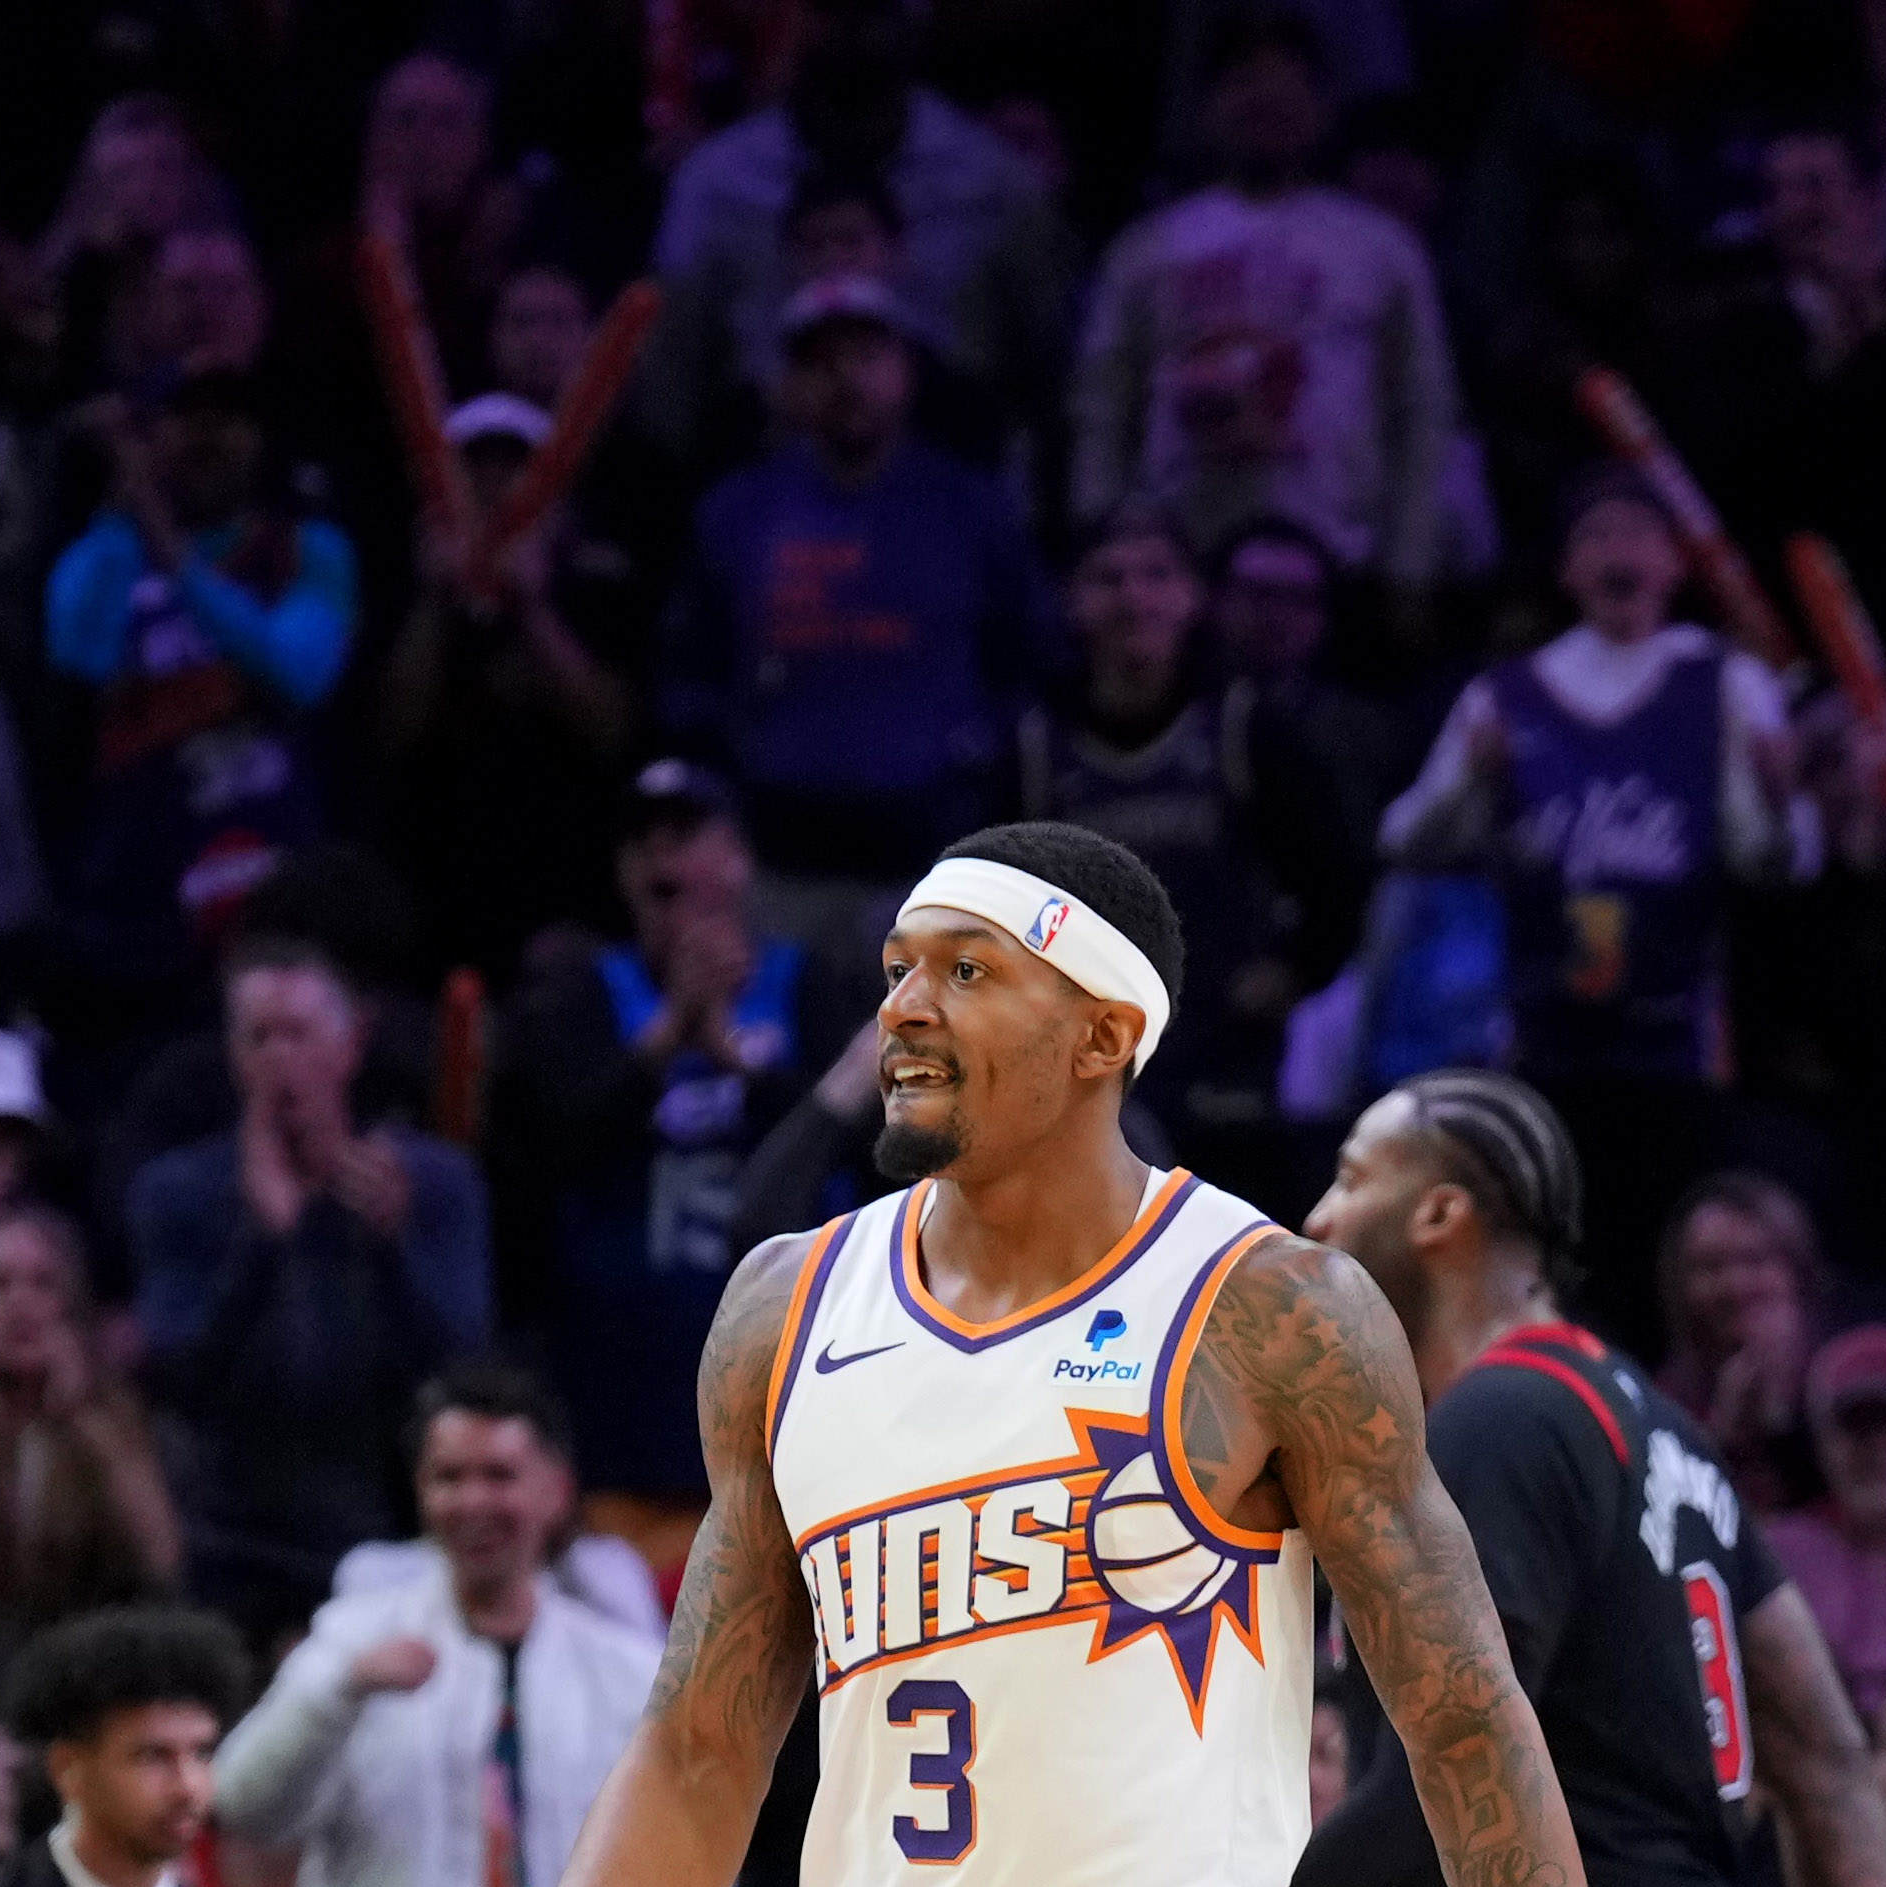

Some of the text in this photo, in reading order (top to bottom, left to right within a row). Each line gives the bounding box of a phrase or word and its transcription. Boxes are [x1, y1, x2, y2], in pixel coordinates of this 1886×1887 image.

[1053, 1359, 1142, 1382] PayPal
[800, 1478, 1071, 1691] UNS
[886, 1679, 977, 1866] 3
